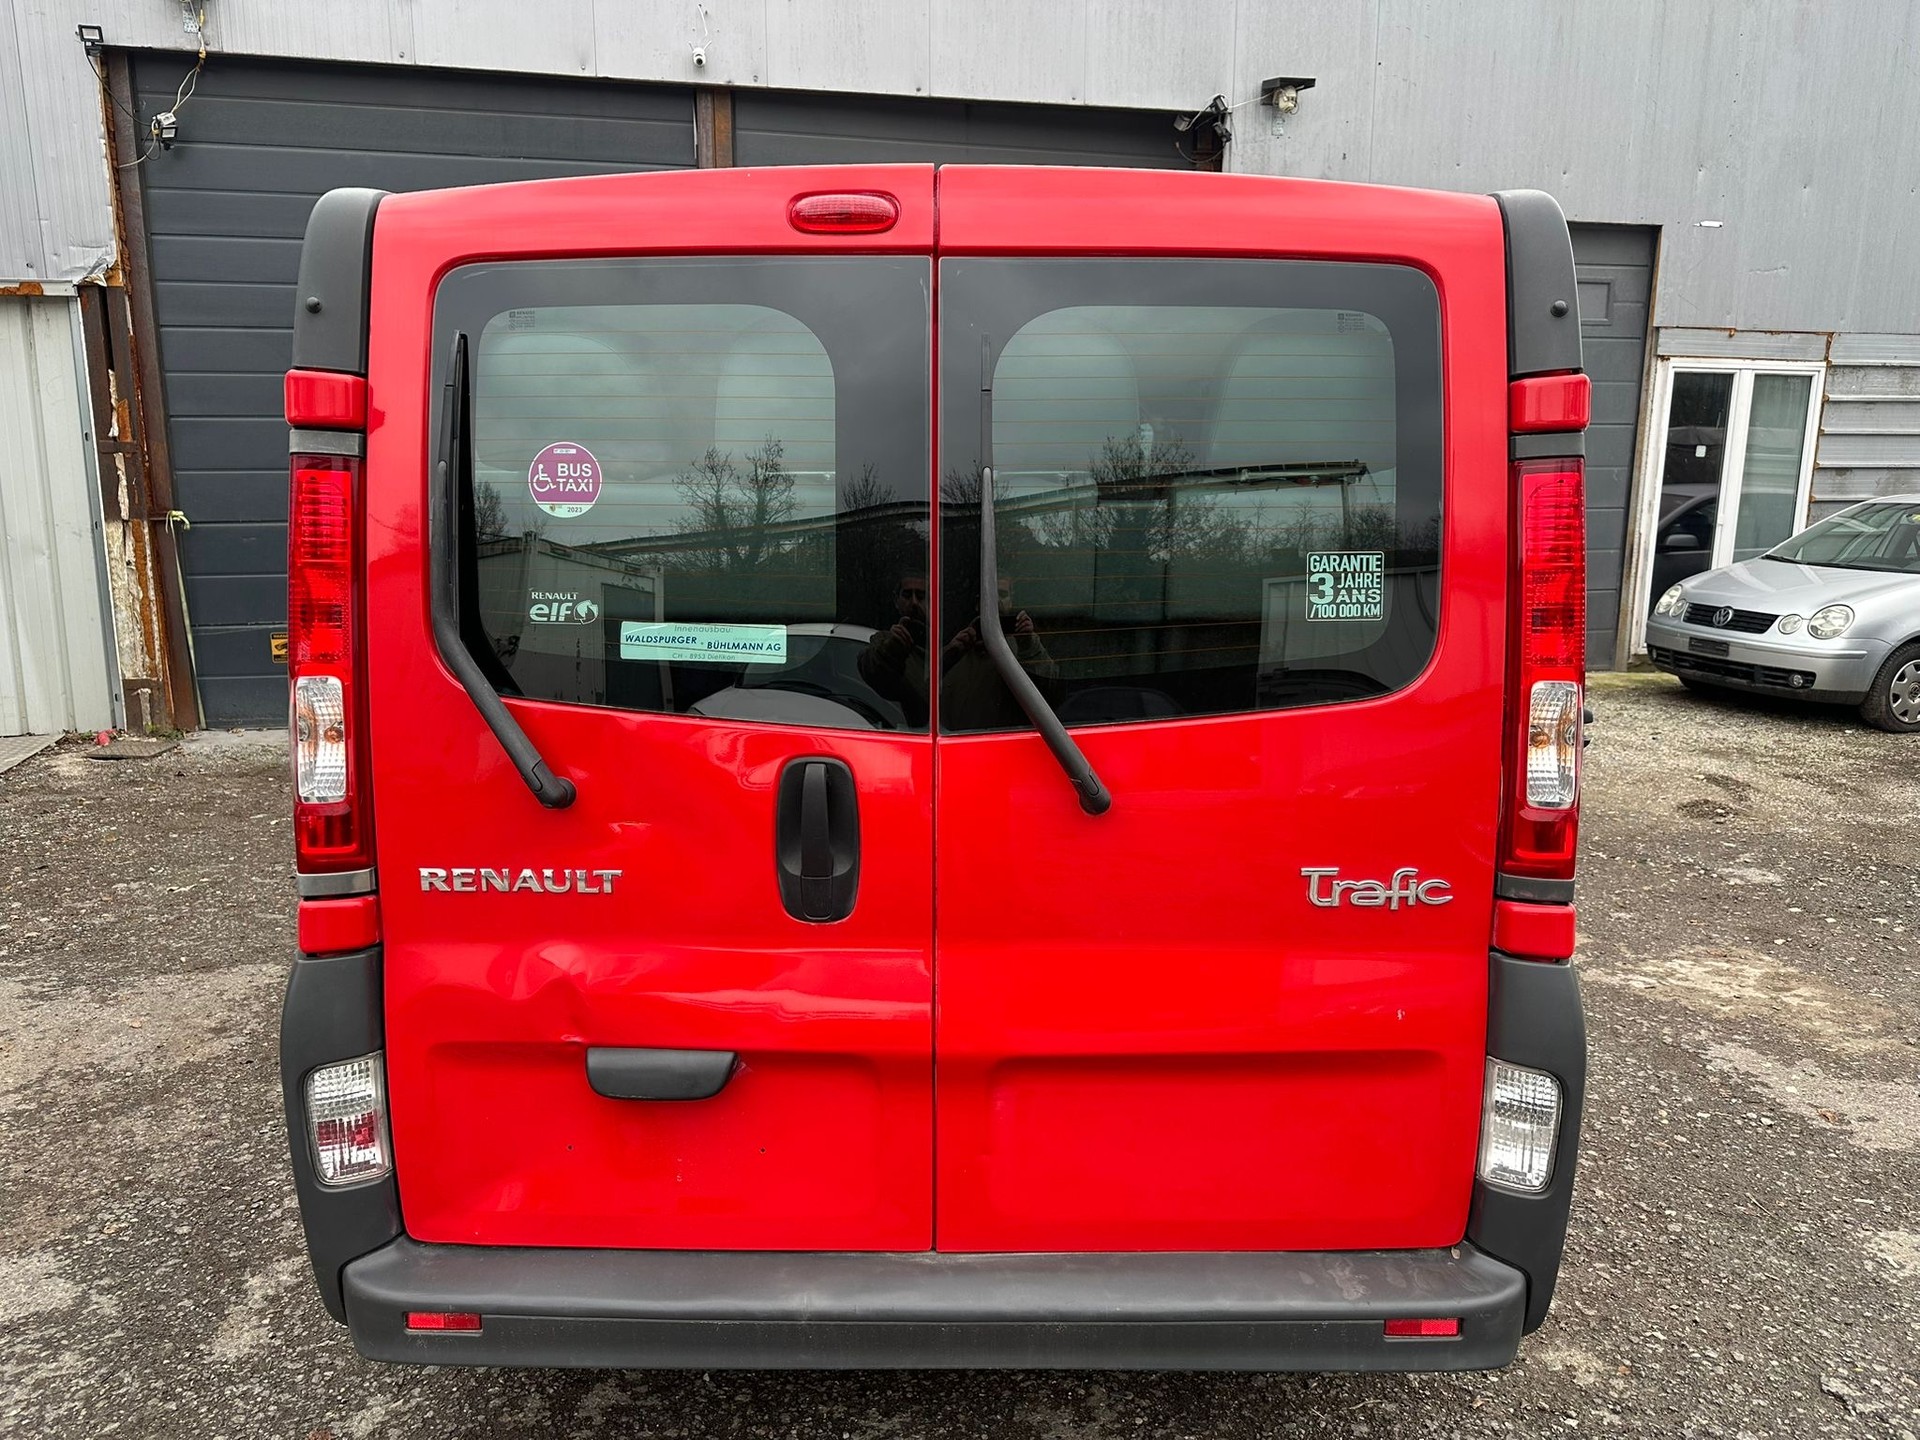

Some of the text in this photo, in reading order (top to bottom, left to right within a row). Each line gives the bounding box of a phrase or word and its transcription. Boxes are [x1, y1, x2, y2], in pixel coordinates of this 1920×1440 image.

[557, 463, 592, 477] BUS
[1310, 554, 1382, 572] GARANTIE
[531, 591, 579, 600] RENAULT
[1309, 572, 1382, 604] 3 JAHRE
[1336, 588, 1381, 603] ANS
[529, 602, 573, 621] elf
[1309, 603, 1380, 618] /100 000 KM
[625, 634, 782, 651] WALDSPURGER BÜHLMANN AG
[689, 652, 706, 660] 8953
[418, 867, 623, 894] RENAULT
[1300, 867, 1454, 910] Trafic
